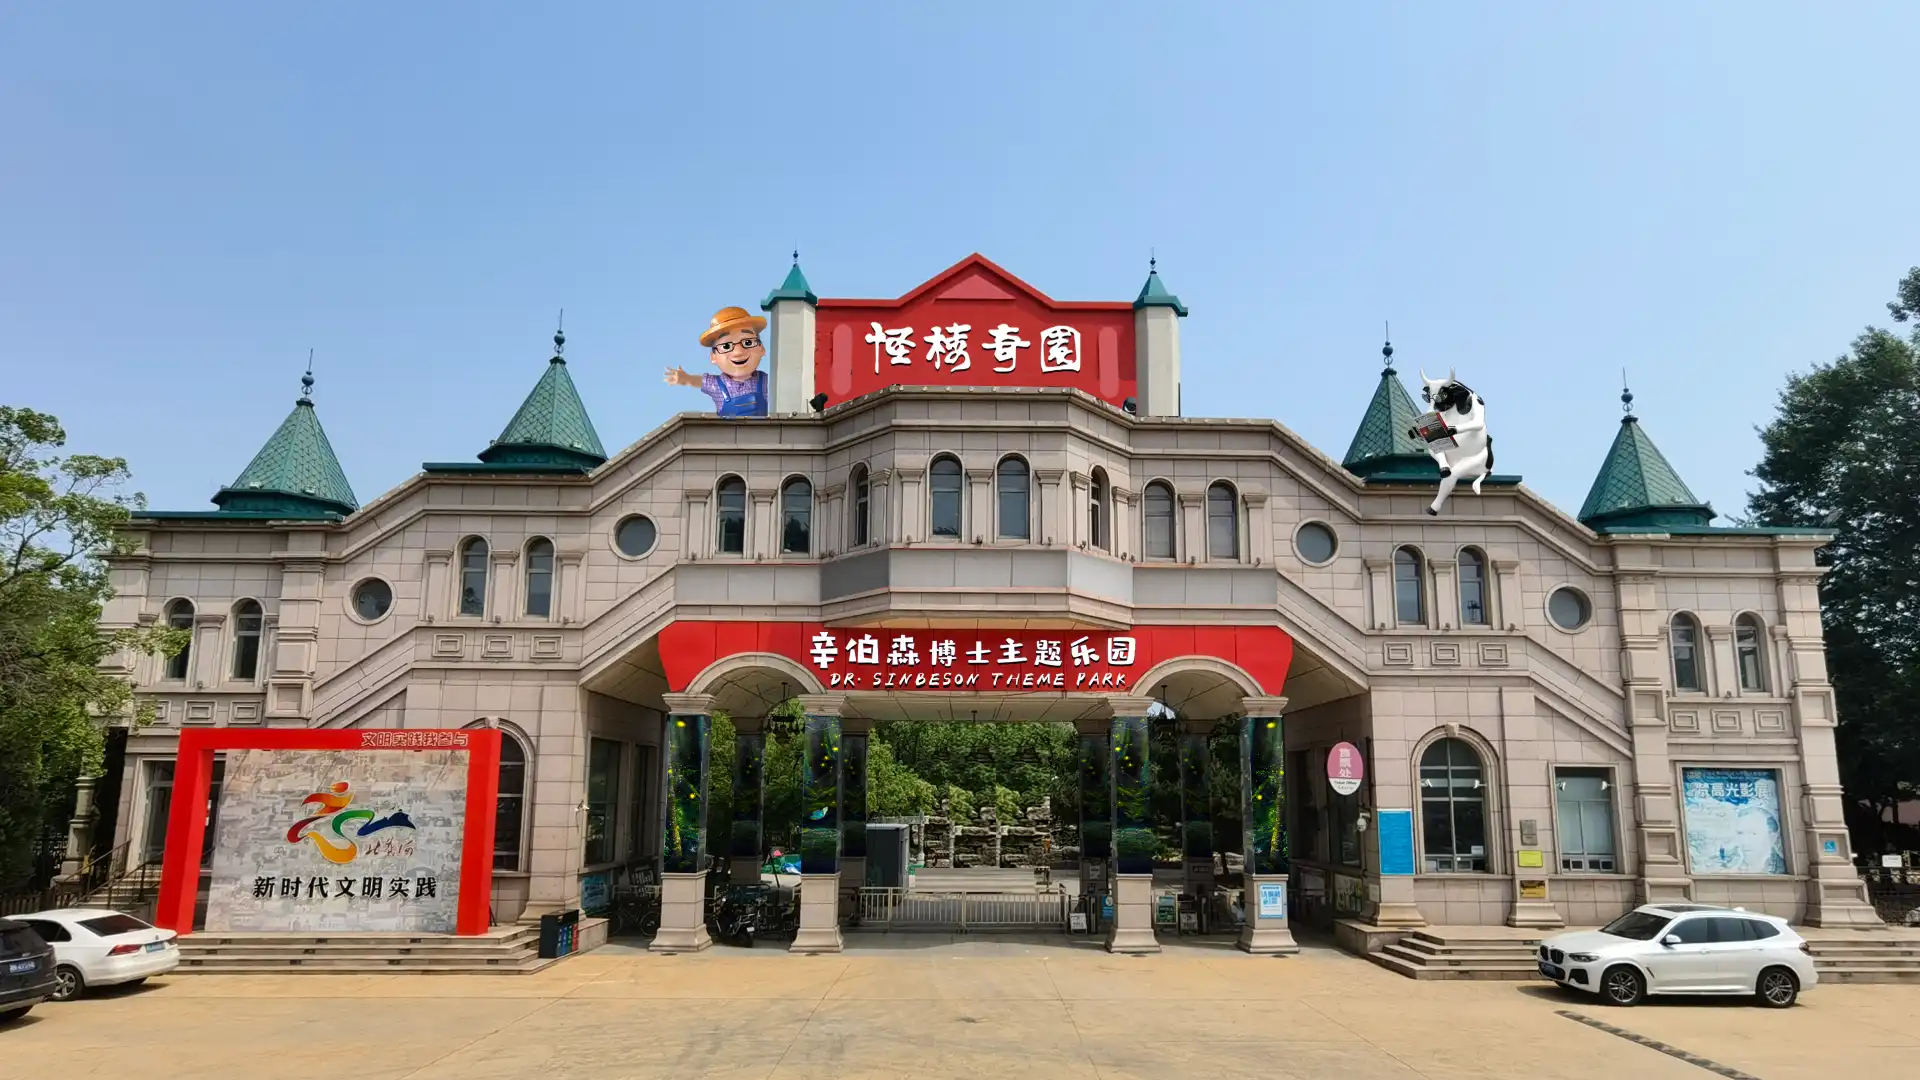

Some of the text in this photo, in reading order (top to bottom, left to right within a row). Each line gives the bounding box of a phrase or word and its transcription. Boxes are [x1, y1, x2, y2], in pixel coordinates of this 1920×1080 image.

[810, 632, 1136, 668] 辛伯森博士主题乐园
[873, 672, 980, 687] SINBESON
[992, 672, 1065, 686] THEME
[1076, 672, 1126, 686] PARK
[252, 876, 437, 899] 新时代文明实践
